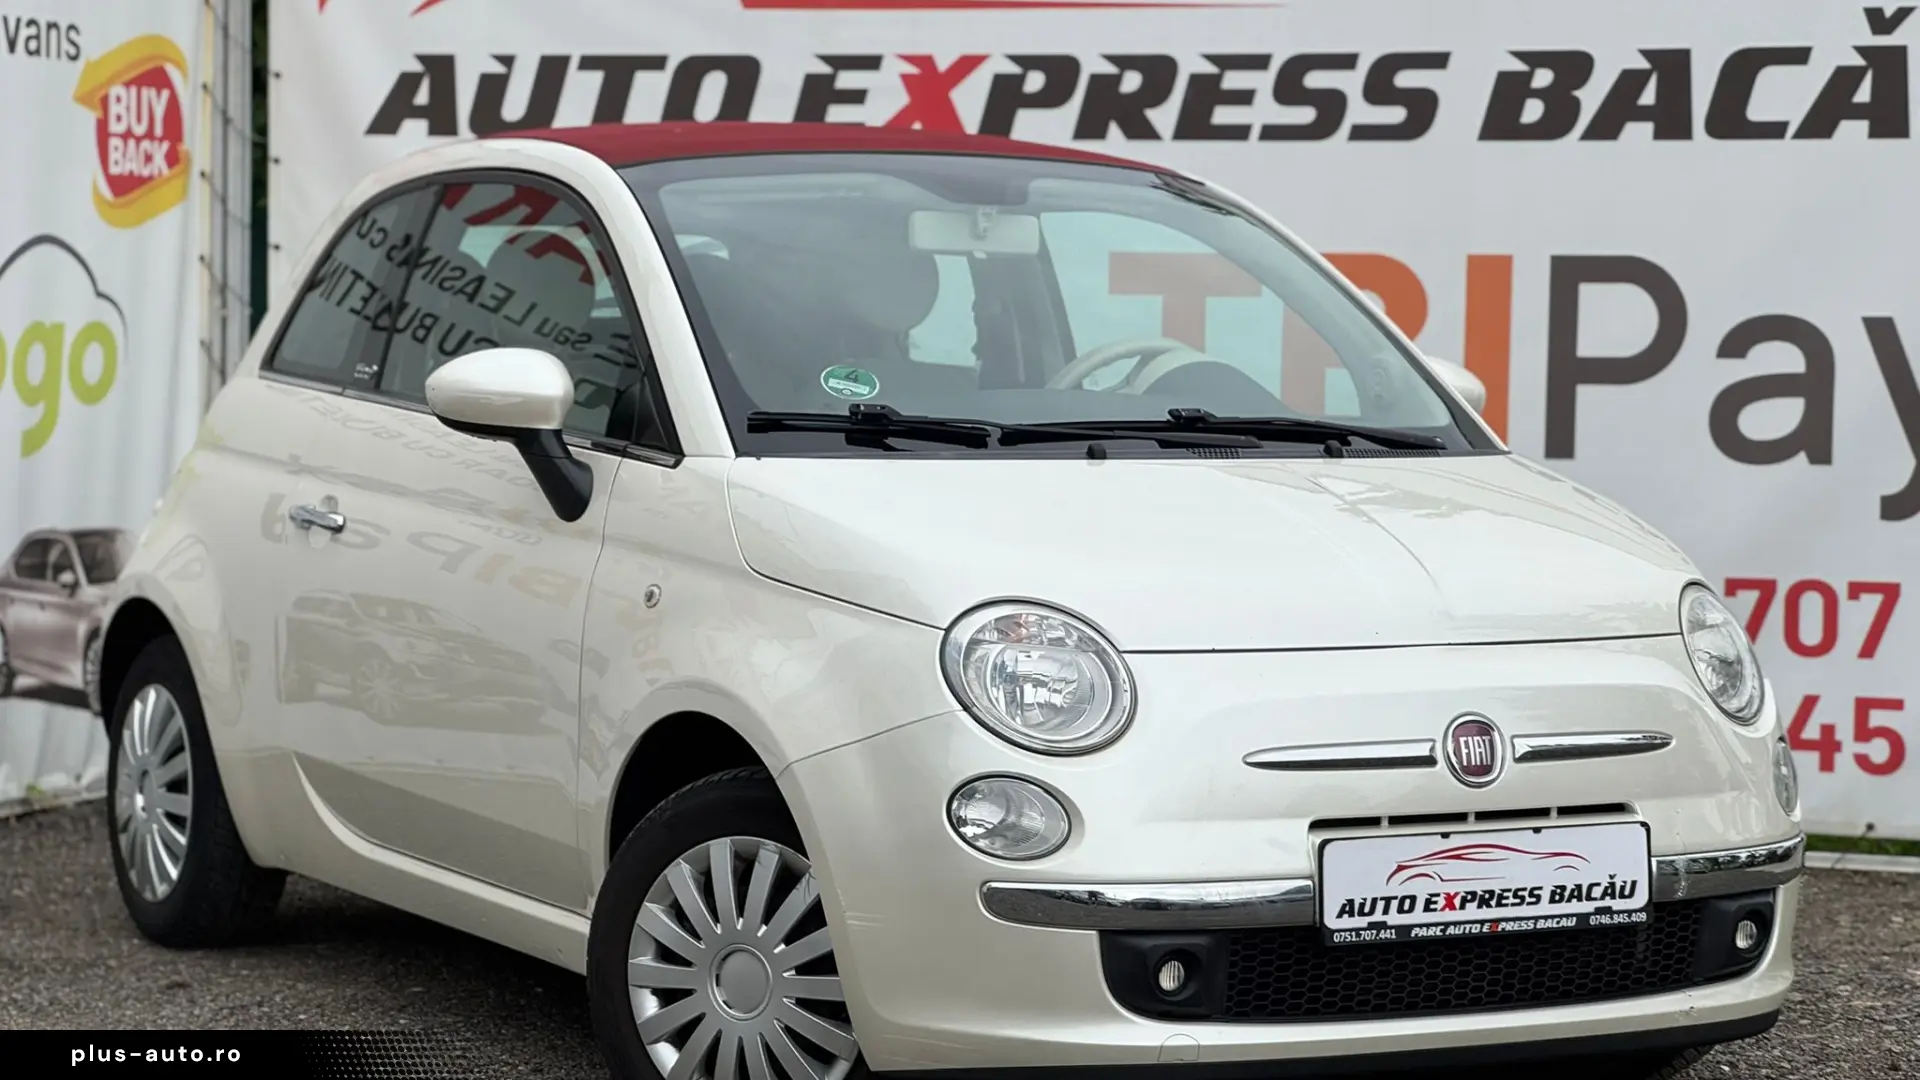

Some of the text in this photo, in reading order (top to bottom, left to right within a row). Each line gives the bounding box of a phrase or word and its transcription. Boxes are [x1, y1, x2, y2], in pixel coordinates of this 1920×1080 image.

[2, 14, 82, 61] vans
[108, 84, 171, 138] BUY
[364, 53, 761, 137] AUTO
[791, 51, 1452, 142] EXPRESS
[108, 137, 171, 178] BACK
[0, 320, 119, 459] go
[1723, 577, 1902, 660] 707
[1458, 735, 1491, 766] FIAT
[1787, 694, 1908, 777] 45
[1335, 873, 1638, 919] AUTO EXPRESS BACĂU
[1589, 911, 1648, 926] 0746.845.409
[1333, 928, 1397, 943] 0751.707.441
[1410, 916, 1577, 938] PARC AUTO EXPRESS BACAU
